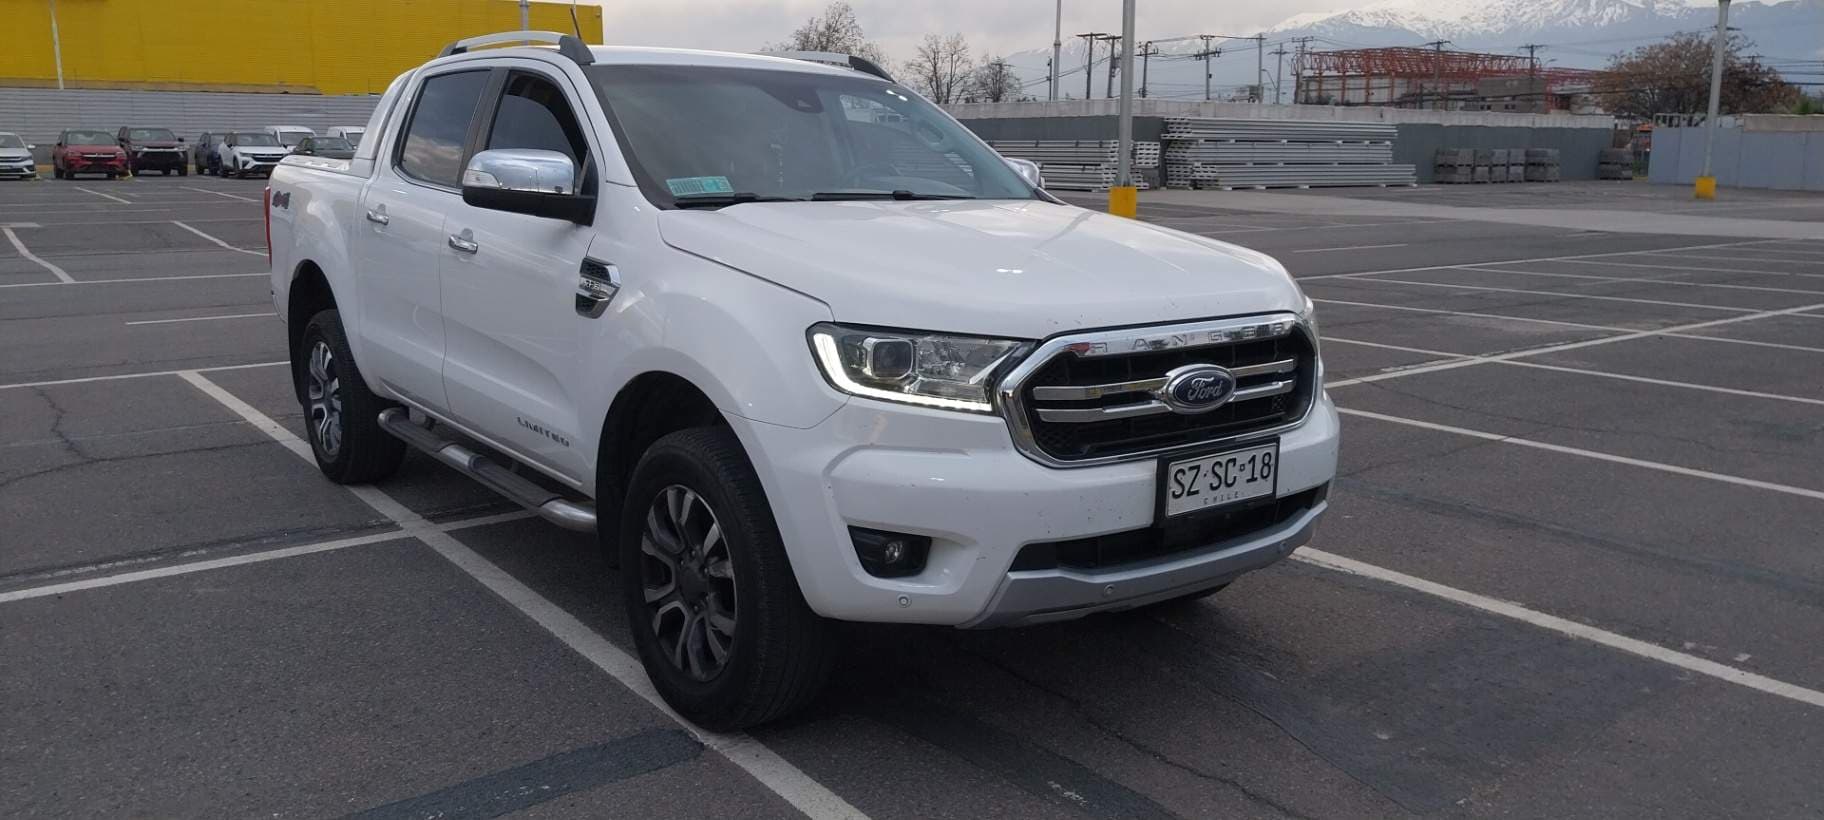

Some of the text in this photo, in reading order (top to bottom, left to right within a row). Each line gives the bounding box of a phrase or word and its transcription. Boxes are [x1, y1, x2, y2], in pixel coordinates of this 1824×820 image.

[1089, 322, 1285, 353] RANGER
[1187, 377, 1223, 400] Ford
[517, 416, 570, 447] LIMITED
[1203, 491, 1239, 505] CHILE
